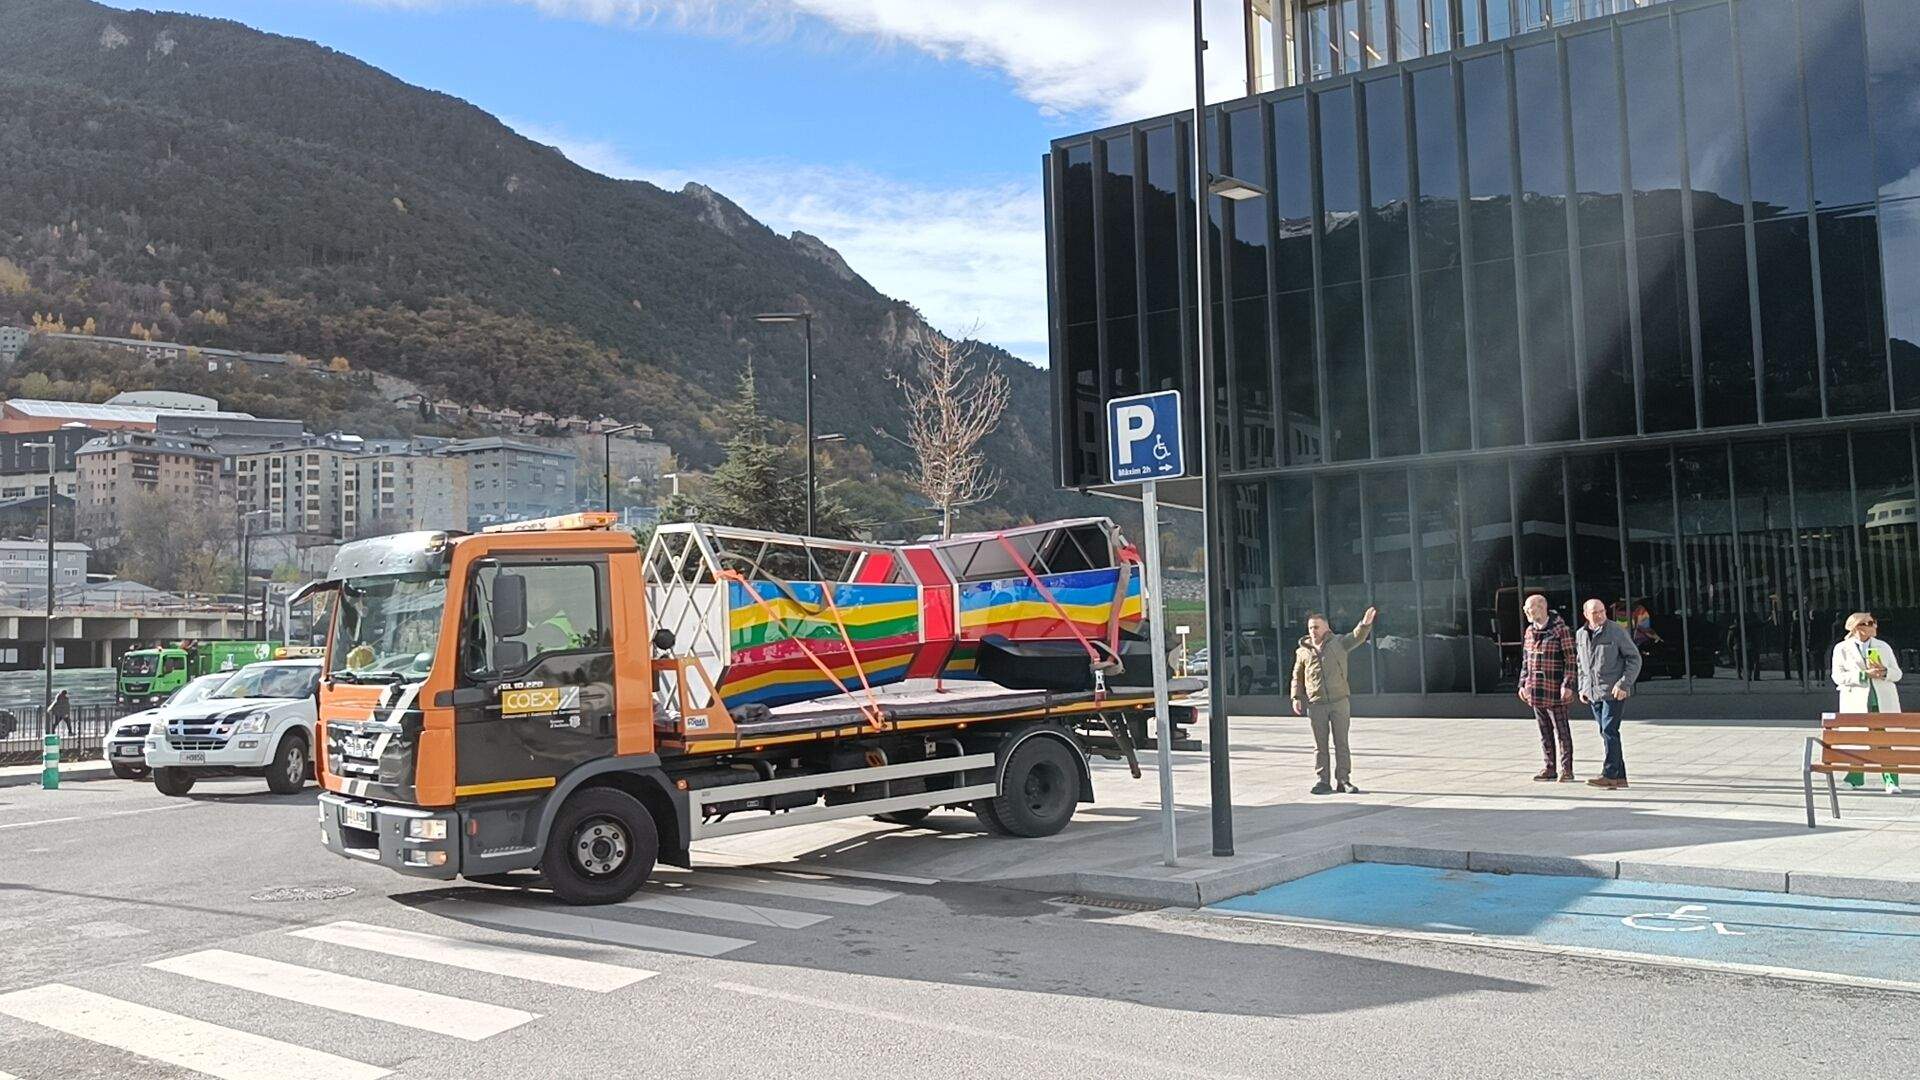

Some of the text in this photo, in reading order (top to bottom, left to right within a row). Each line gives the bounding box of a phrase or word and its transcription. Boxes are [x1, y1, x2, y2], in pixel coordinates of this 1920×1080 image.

[1116, 404, 1155, 465] P
[1142, 466, 1151, 474] 2h
[507, 691, 554, 708] COEX
